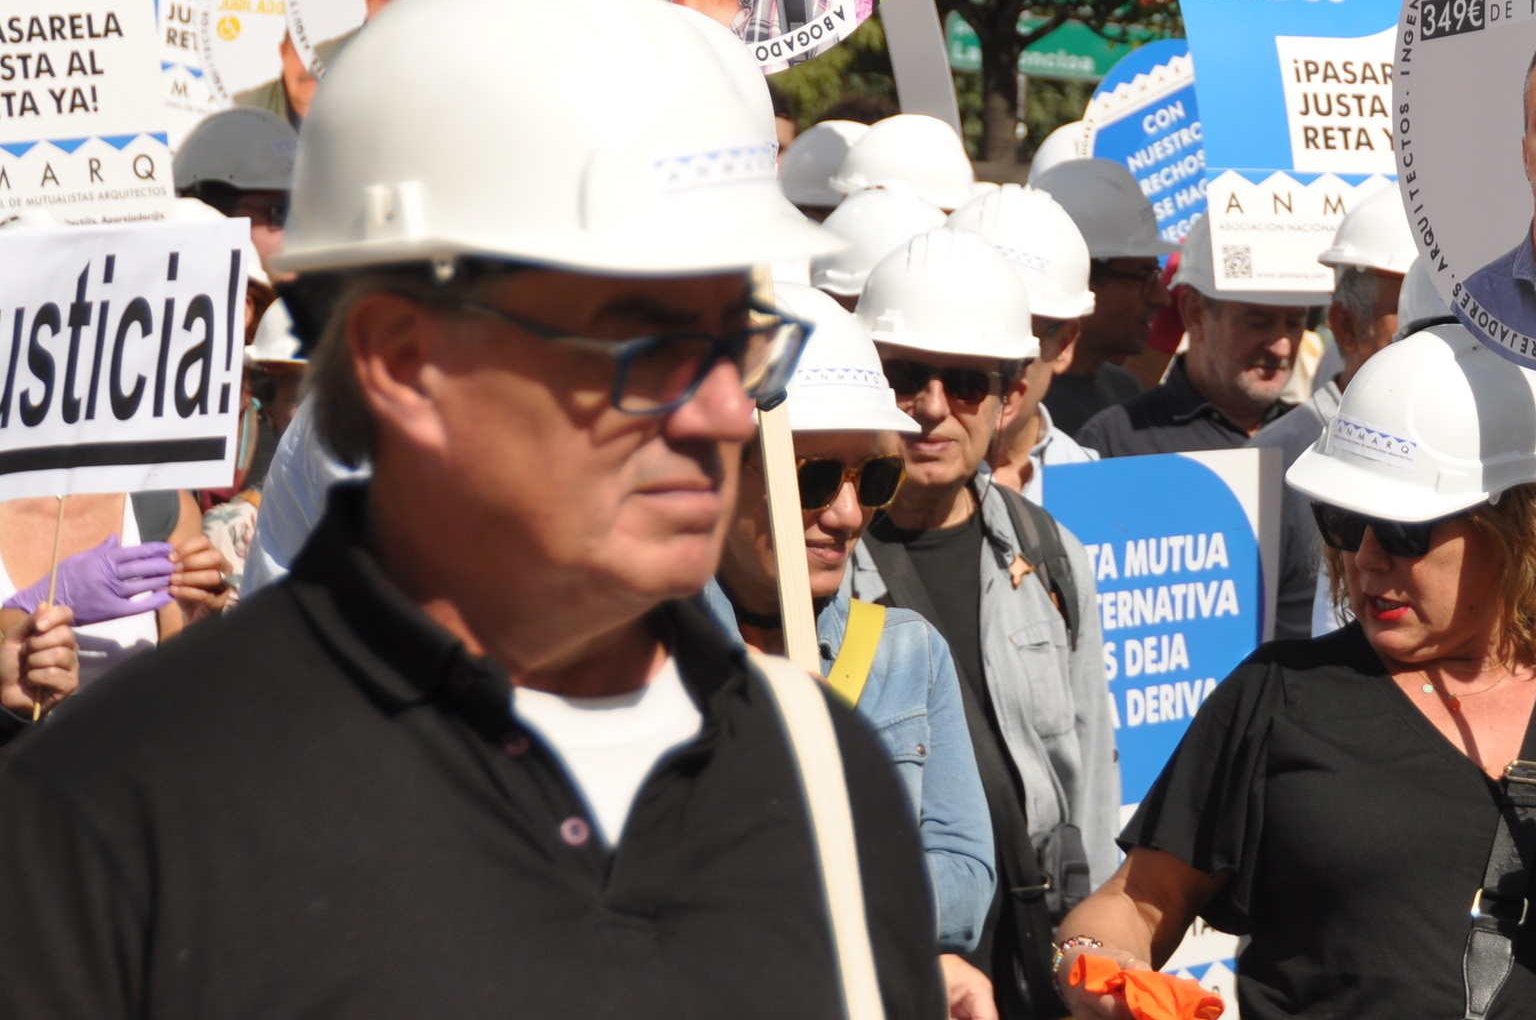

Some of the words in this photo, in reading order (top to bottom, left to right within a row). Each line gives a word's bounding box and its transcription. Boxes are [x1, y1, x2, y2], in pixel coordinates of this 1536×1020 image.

[1490, 1, 1513, 22] DE
[67, 50, 104, 77] AL
[48, 85, 98, 114] YA!
[1299, 92, 1389, 118] JUSTA
[1142, 100, 1186, 135] CON
[1302, 125, 1375, 151] RETA
[9, 197, 22, 207] DE
[26, 191, 94, 206] MUTUALISTAS
[98, 186, 167, 200] ARQUITECTOS
[1152, 198, 1175, 222] SE
[1124, 532, 1229, 578] MUTUA
[1124, 632, 1190, 677] DEJA
